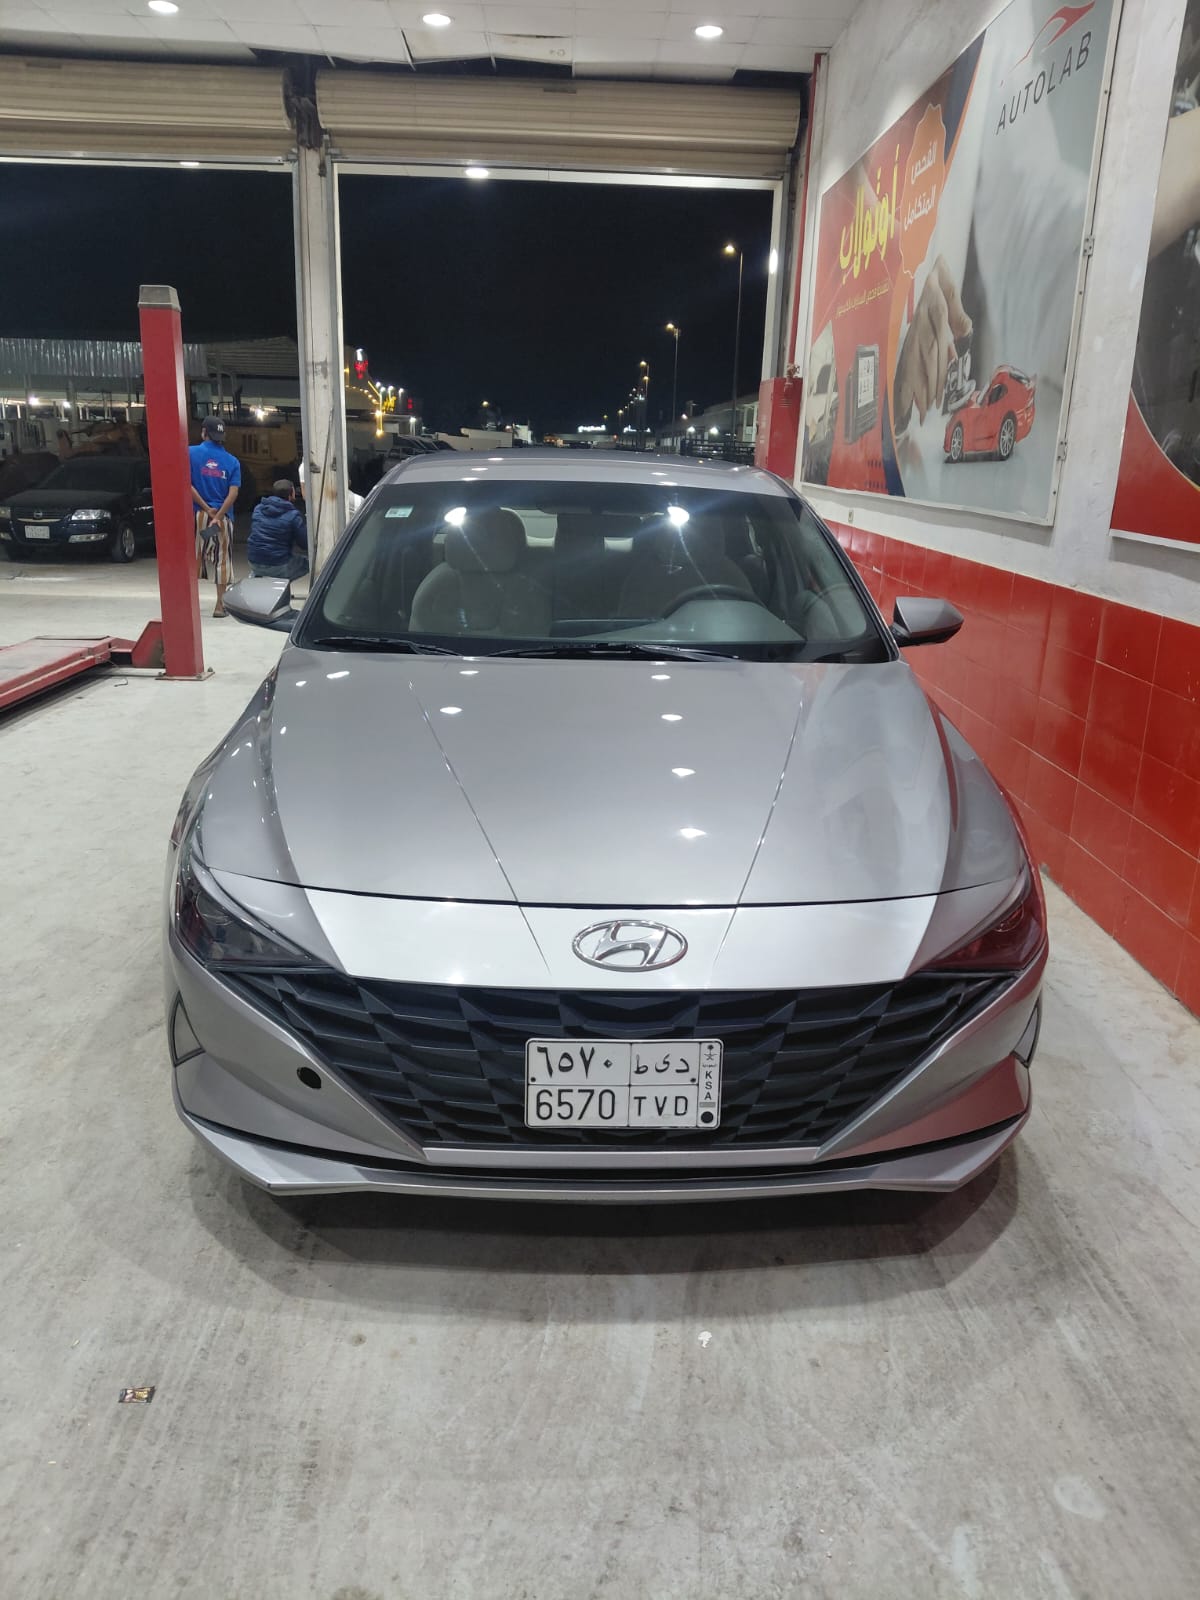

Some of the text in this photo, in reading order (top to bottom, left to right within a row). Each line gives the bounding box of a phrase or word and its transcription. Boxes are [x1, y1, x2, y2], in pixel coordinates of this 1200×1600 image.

[996, 31, 1092, 136] AUTOLAB
[537, 1046, 613, 1079] ٦٥٧٠
[536, 1089, 616, 1120] 6570
